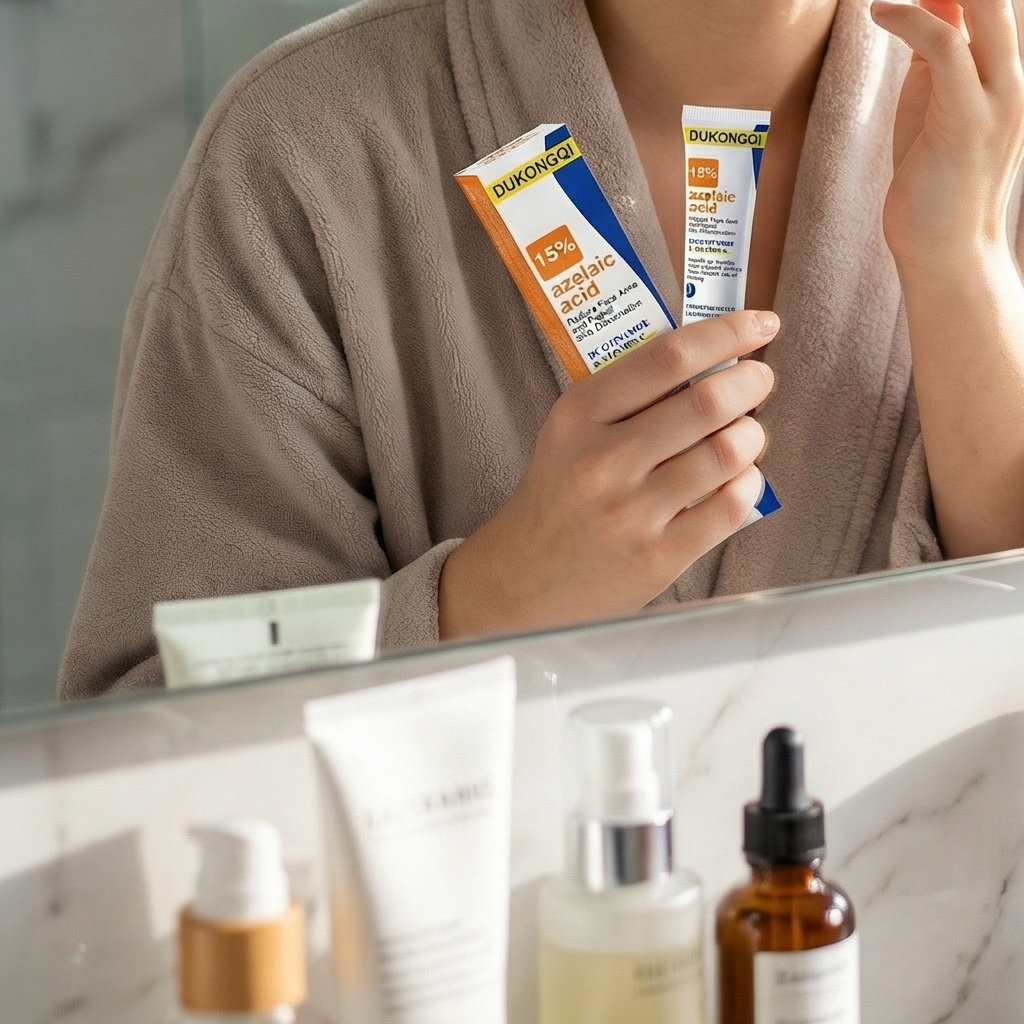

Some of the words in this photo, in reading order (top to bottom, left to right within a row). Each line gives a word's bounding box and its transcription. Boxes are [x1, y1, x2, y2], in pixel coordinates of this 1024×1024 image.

[689, 130, 762, 146] DUKONGQI
[492, 143, 575, 199] DUKONGQI
[534, 237, 577, 268] 15%
[551, 253, 616, 299] azelaic
[561, 280, 601, 314] acid
